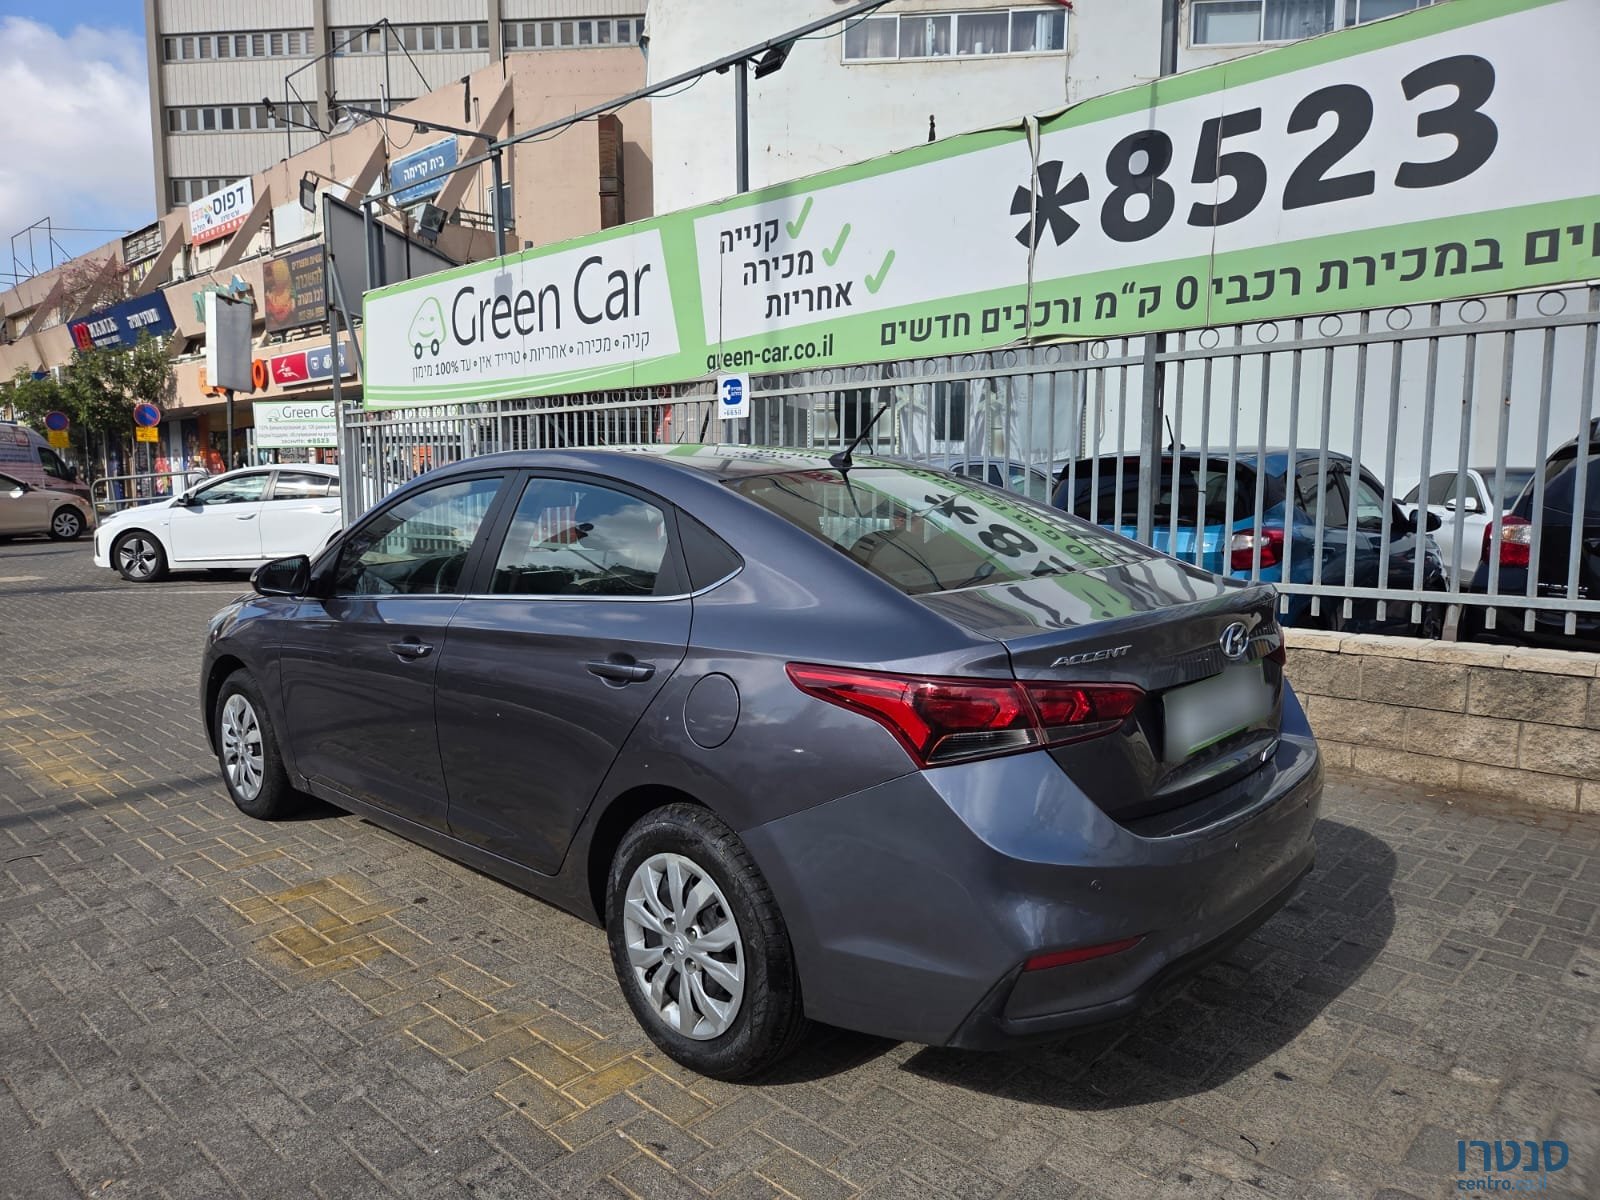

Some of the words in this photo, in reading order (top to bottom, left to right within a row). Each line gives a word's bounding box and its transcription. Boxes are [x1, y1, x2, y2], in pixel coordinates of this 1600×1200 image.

[430, 155, 445, 171] בית
[212, 186, 244, 215] דפוס
[720, 218, 779, 255] קנייה
[1525, 222, 1600, 266] ים
[743, 249, 814, 286] מכירה
[1315, 238, 1504, 294] במכירת
[1175, 275, 1199, 310] 0
[1211, 266, 1302, 305] רכבי
[450, 286, 561, 346] Green
[573, 255, 651, 325] Car
[765, 280, 853, 319] אחריות
[981, 297, 1081, 334] ורכבים
[622, 330, 650, 352] קניה
[880, 312, 971, 346] חדשים
[495, 350, 521, 367] טרייד
[529, 343, 567, 363] אחריות
[576, 336, 611, 356] מכירה
[412, 363, 433, 383] מימון
[435, 361, 459, 377] 100%
[460, 358, 471, 372] עד
[479, 354, 492, 374] אין
[282, 405, 319, 419] Green
[321, 404, 336, 418] Ca
[1049, 644, 1133, 668] ACCENT
